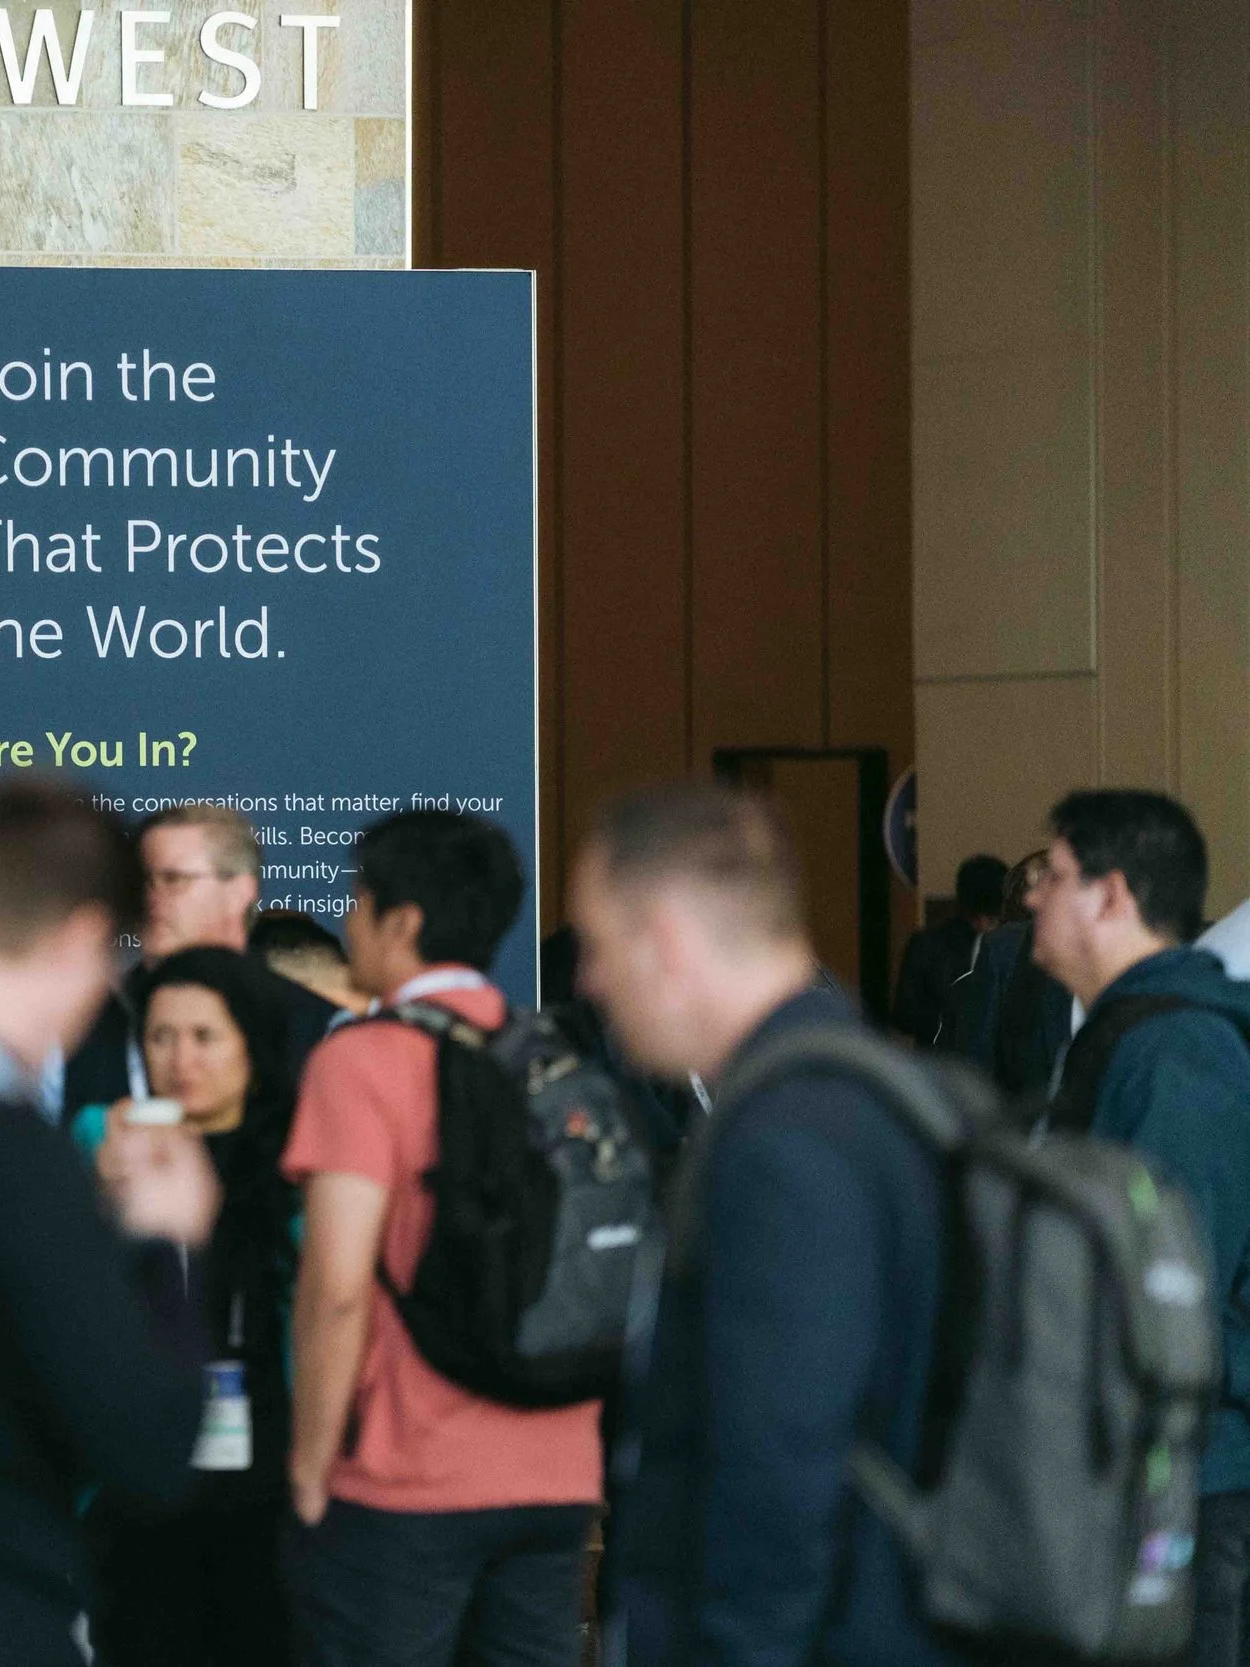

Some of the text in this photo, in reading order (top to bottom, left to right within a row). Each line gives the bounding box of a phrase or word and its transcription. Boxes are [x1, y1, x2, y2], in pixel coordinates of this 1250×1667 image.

[116, 348, 216, 402] the
[127, 519, 382, 574] Protects
[86, 605, 286, 659] World.
[45, 731, 123, 768] You
[139, 731, 198, 767] In?
[91, 793, 126, 812] the
[132, 793, 278, 812] conversations
[284, 793, 325, 812] that
[331, 793, 403, 813] matter,
[410, 793, 450, 812] find
[455, 797, 504, 816] your
[250, 826, 293, 846] kills.
[269, 894, 292, 911] of
[298, 894, 358, 918] insigh
